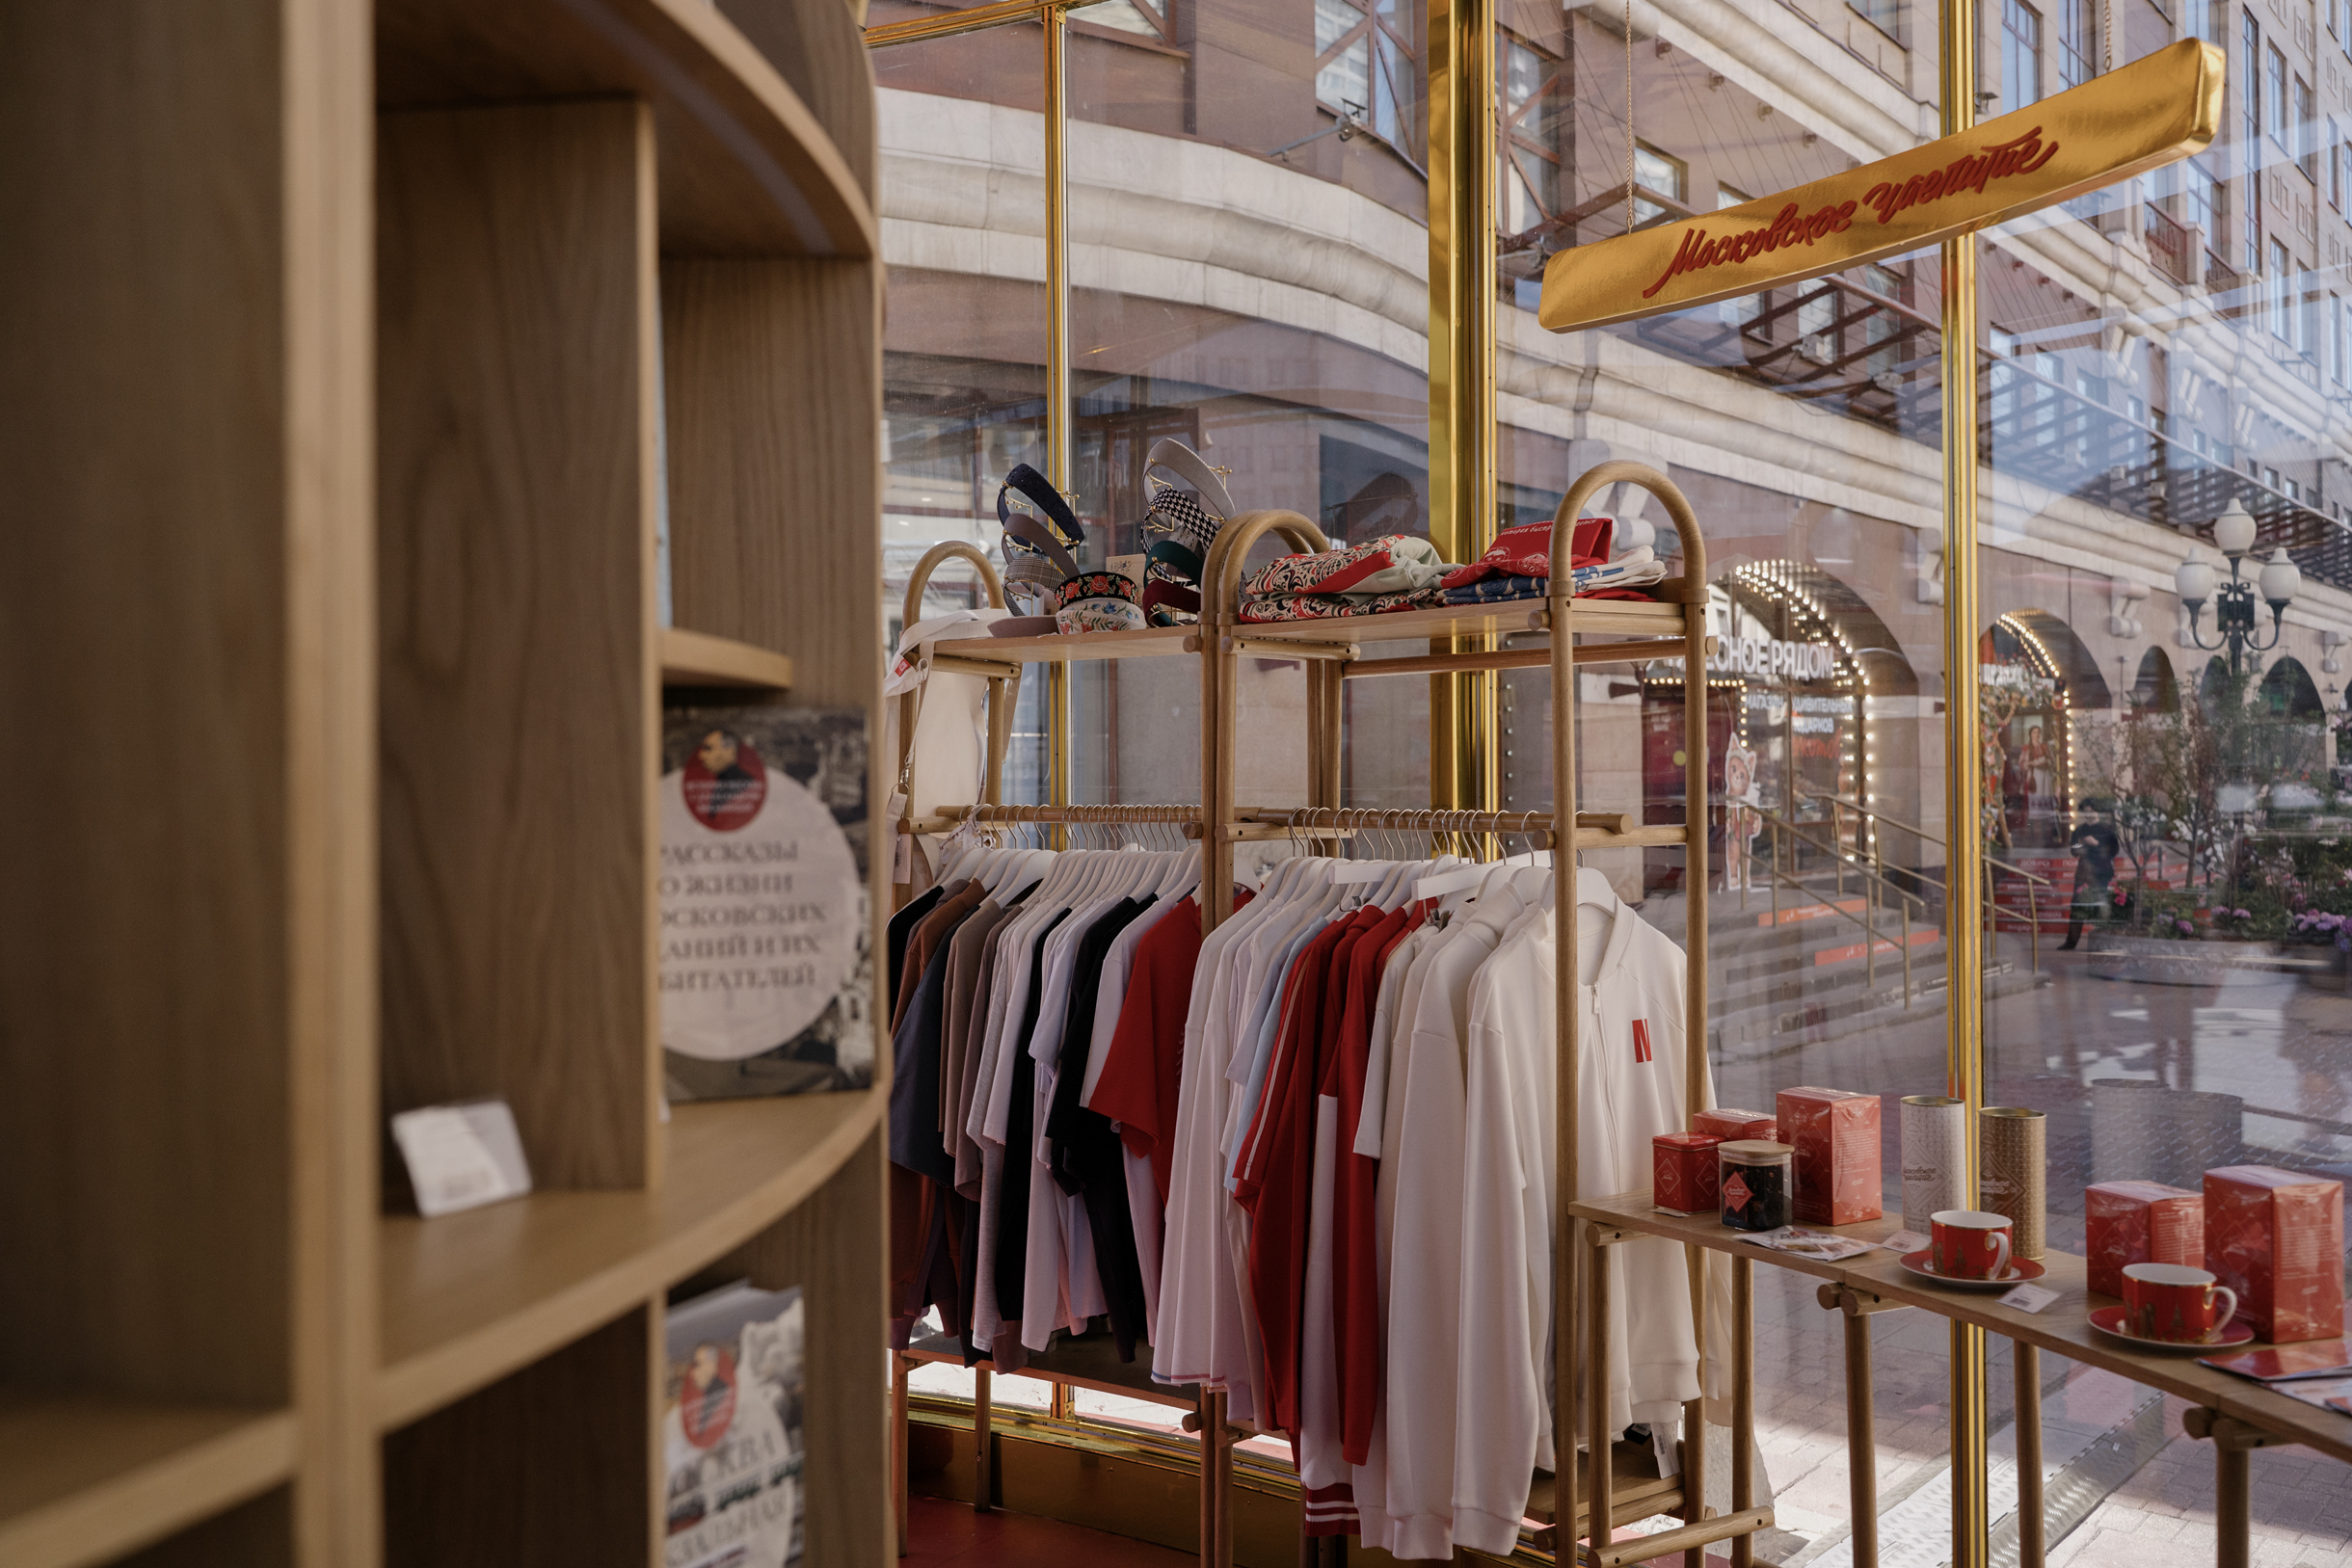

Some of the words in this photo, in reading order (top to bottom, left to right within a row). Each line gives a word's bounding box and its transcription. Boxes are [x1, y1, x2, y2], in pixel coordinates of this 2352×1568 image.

[1643, 202, 1857, 299] Московское
[1862, 126, 2059, 225] чаепитие
[1772, 640, 1834, 681] РЯДОМ
[1745, 694, 1784, 709] МАГАЗИН
